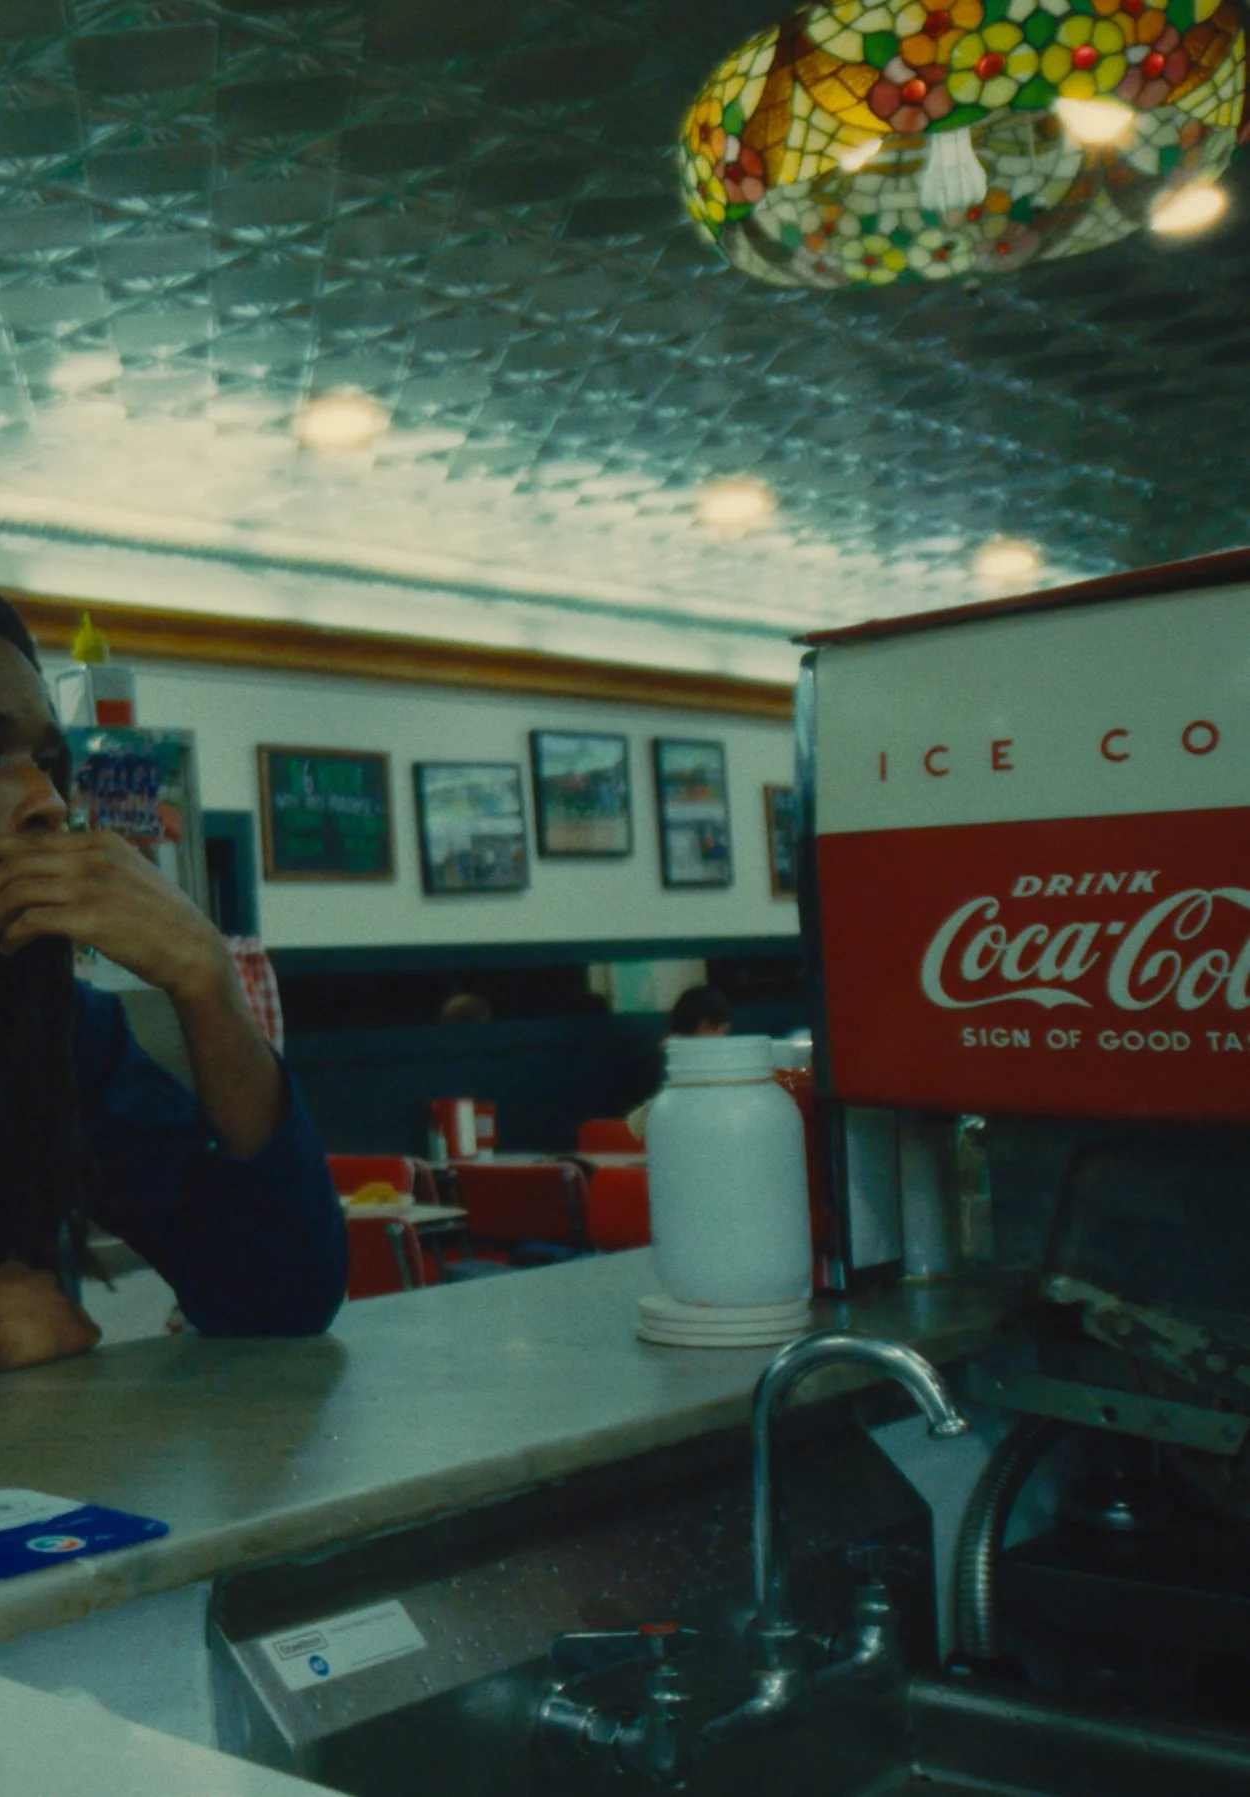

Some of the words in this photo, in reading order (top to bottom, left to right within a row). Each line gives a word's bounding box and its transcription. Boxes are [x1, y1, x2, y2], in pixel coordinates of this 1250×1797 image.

[879, 739, 1014, 781] ICE
[1099, 719, 1221, 763] CO
[1010, 869, 1163, 898] DRINK
[960, 1026, 1031, 1050] SIGN
[1045, 1027, 1084, 1050] OF
[1097, 1028, 1191, 1052] GOOD
[1205, 1030, 1250, 1053] TA
